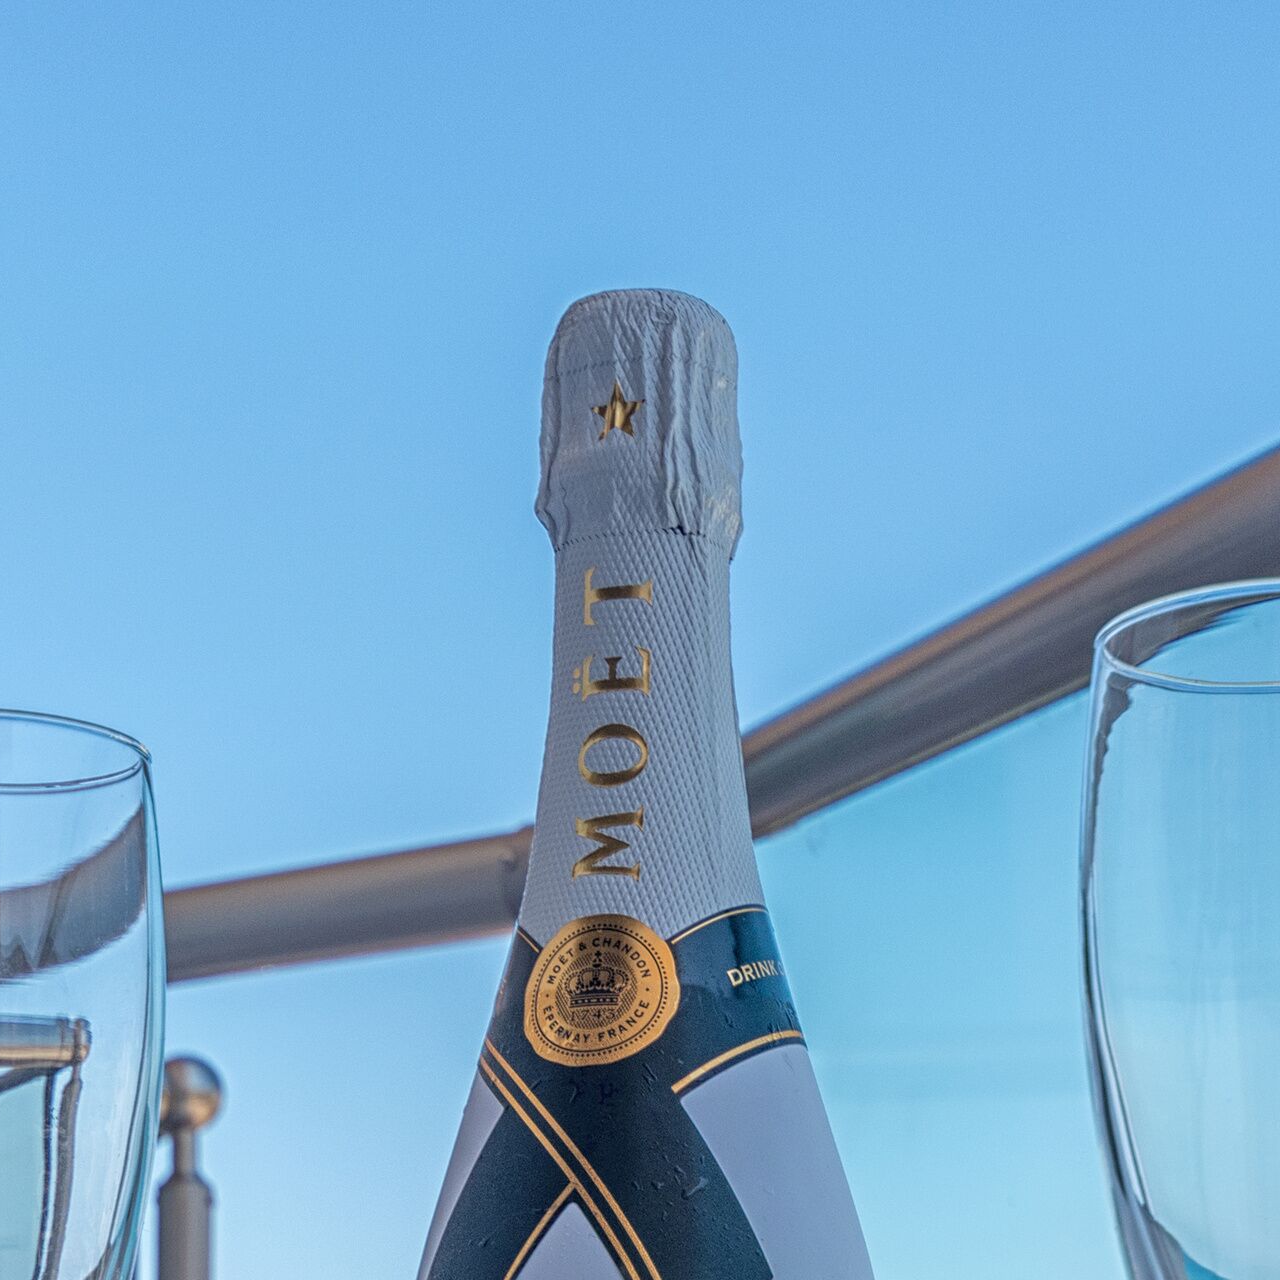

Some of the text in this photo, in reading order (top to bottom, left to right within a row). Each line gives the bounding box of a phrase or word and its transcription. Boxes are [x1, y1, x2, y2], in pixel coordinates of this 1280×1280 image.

[572, 565, 653, 881] MOËT
[578, 942, 589, 951] &
[592, 937, 651, 979] CHANDON
[726, 960, 779, 987] DRINK
[597, 1000, 650, 1042] FRANCE
